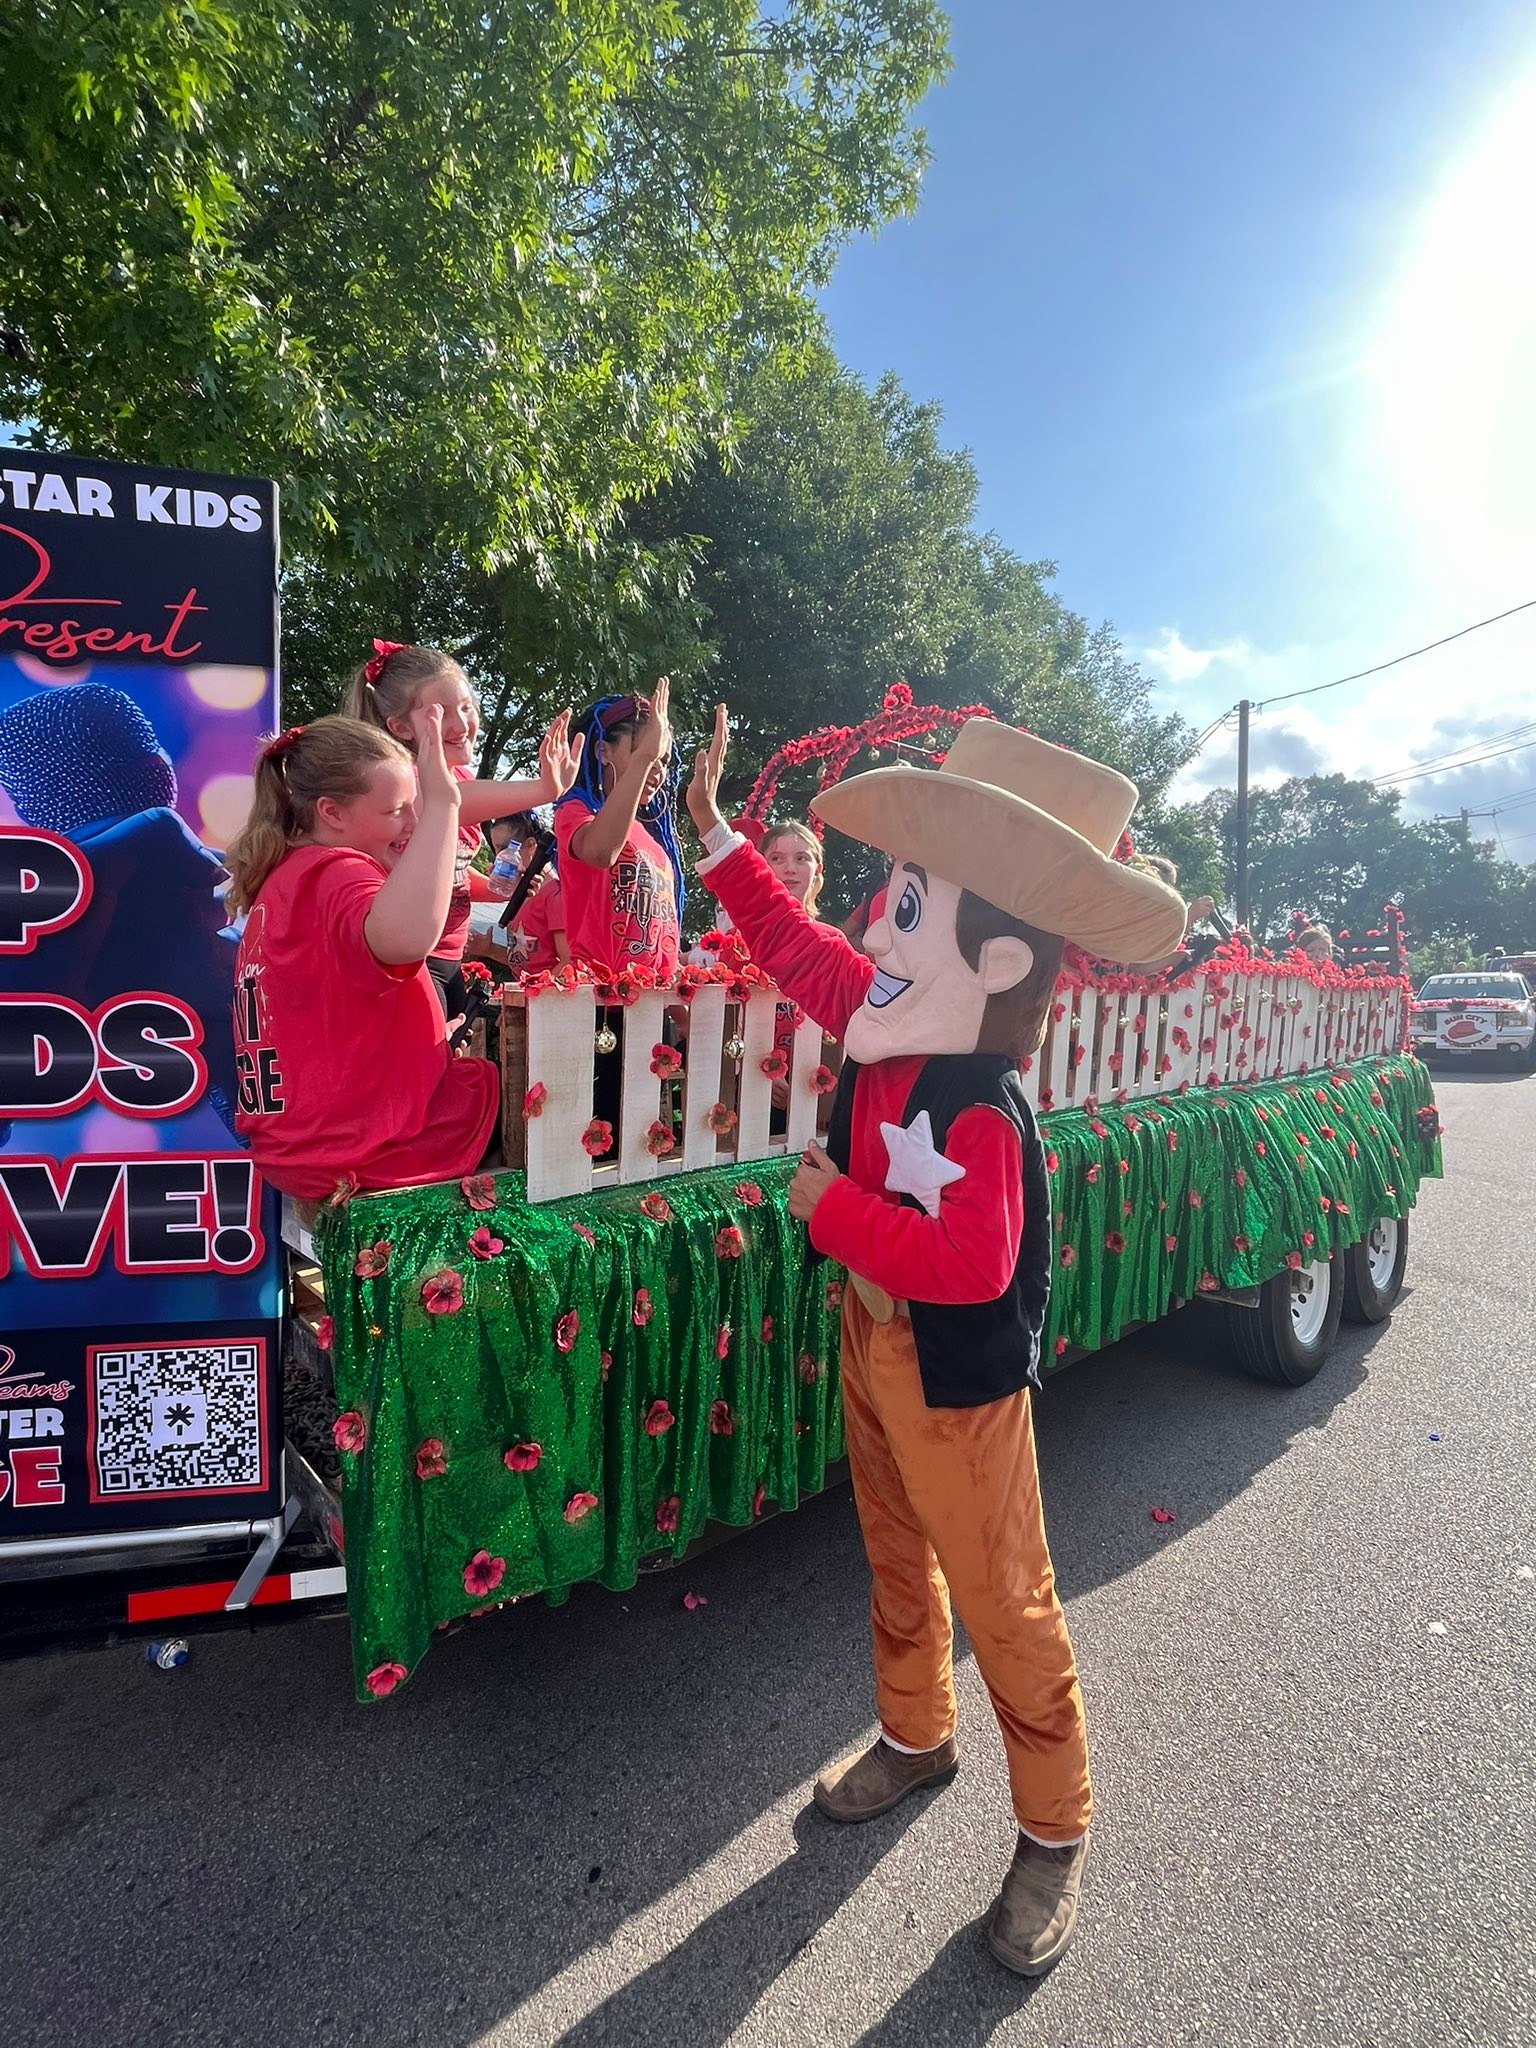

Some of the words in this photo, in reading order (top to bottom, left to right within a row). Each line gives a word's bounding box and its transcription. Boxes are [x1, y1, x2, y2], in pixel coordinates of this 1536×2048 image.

[0, 468, 115, 518] TAR
[135, 482, 263, 533] KIDS
[1465, 1014, 1488, 1025] CITY
